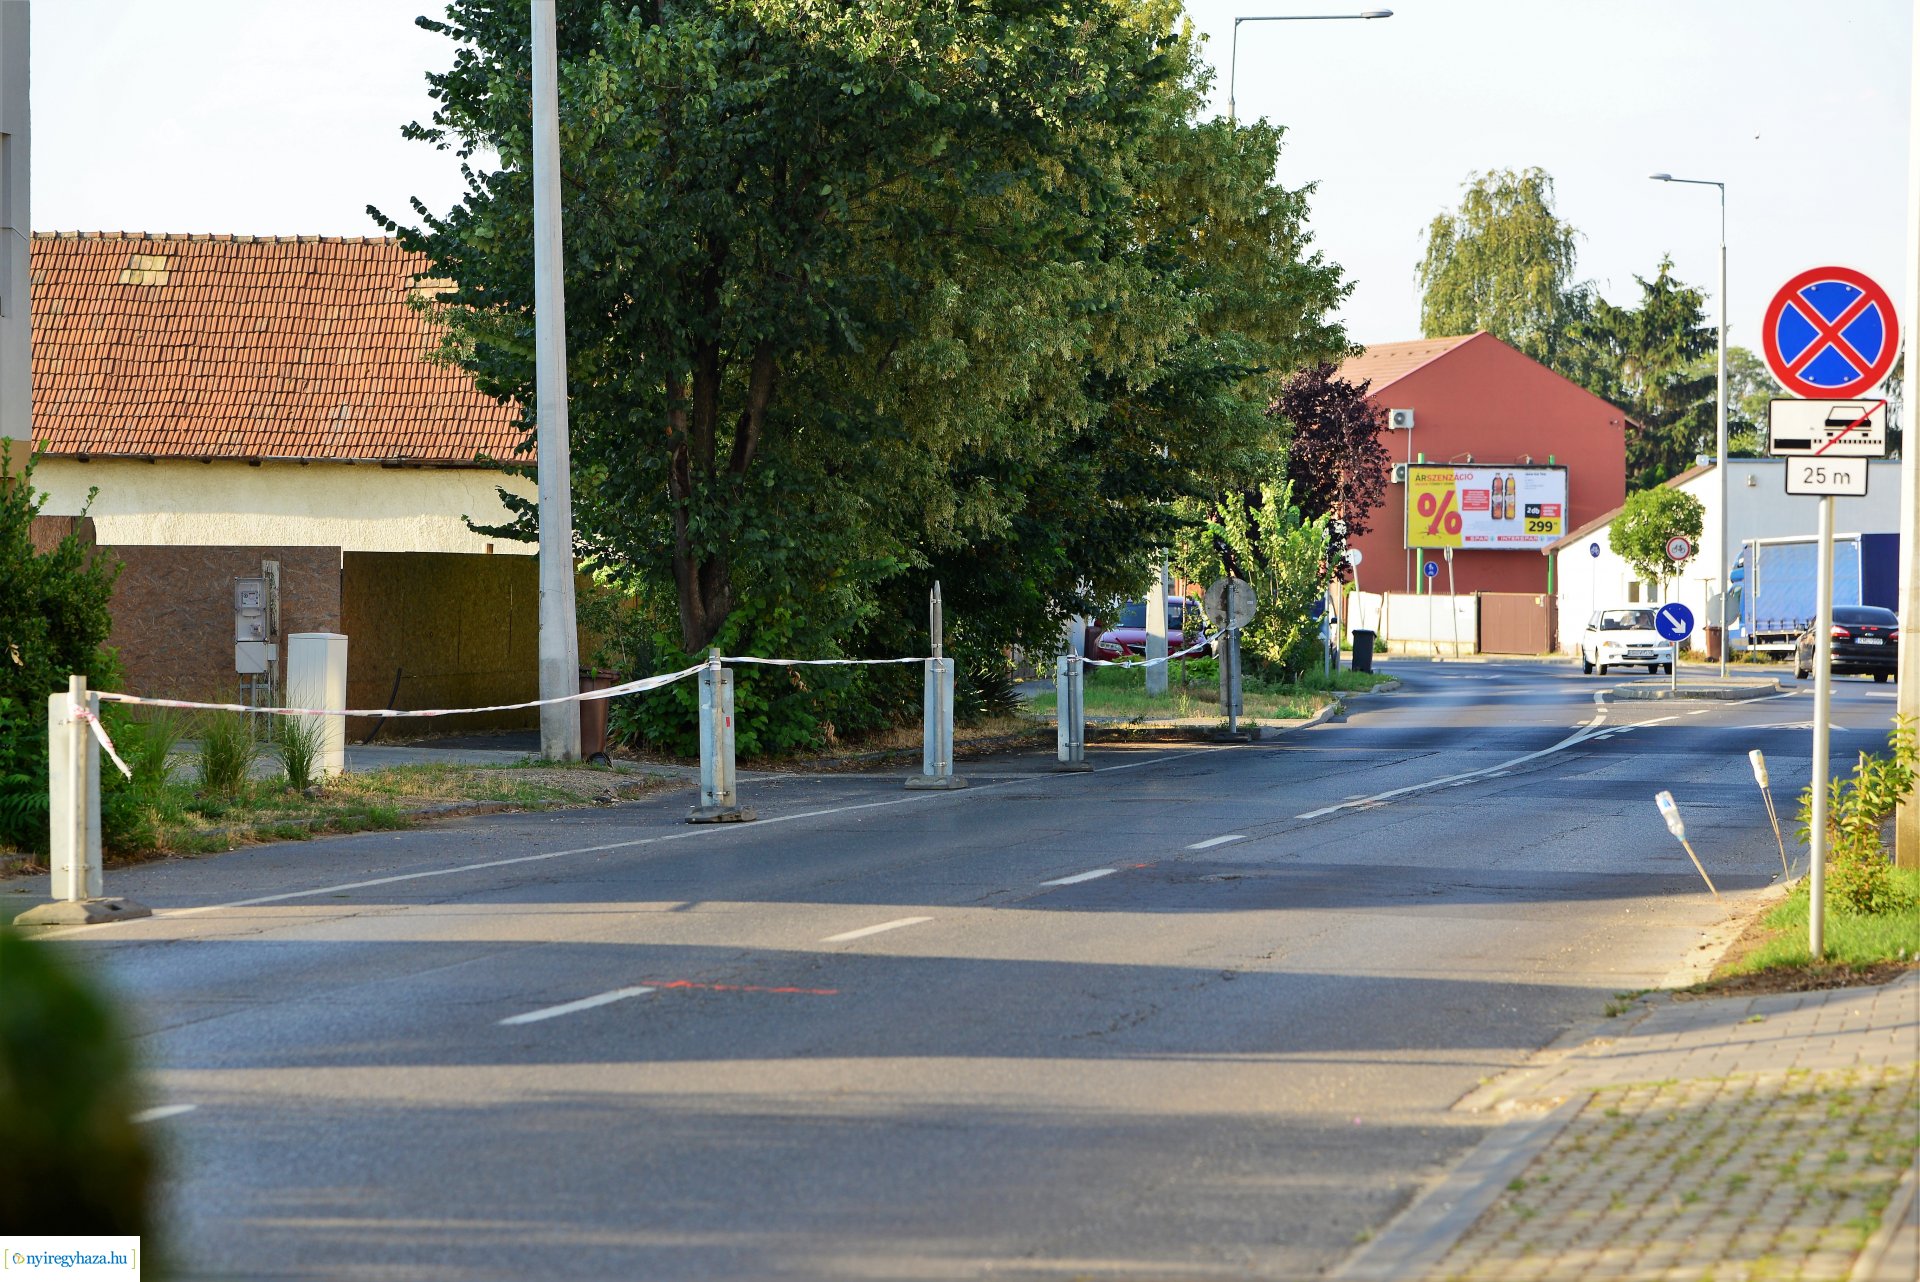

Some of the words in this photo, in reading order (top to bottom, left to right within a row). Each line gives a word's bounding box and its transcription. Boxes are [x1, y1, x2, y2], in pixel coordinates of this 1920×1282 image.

[1803, 467, 1826, 484] 25
[1833, 472, 1851, 485] m
[1526, 507, 1541, 515] 2db
[1528, 520, 1554, 532] 299
